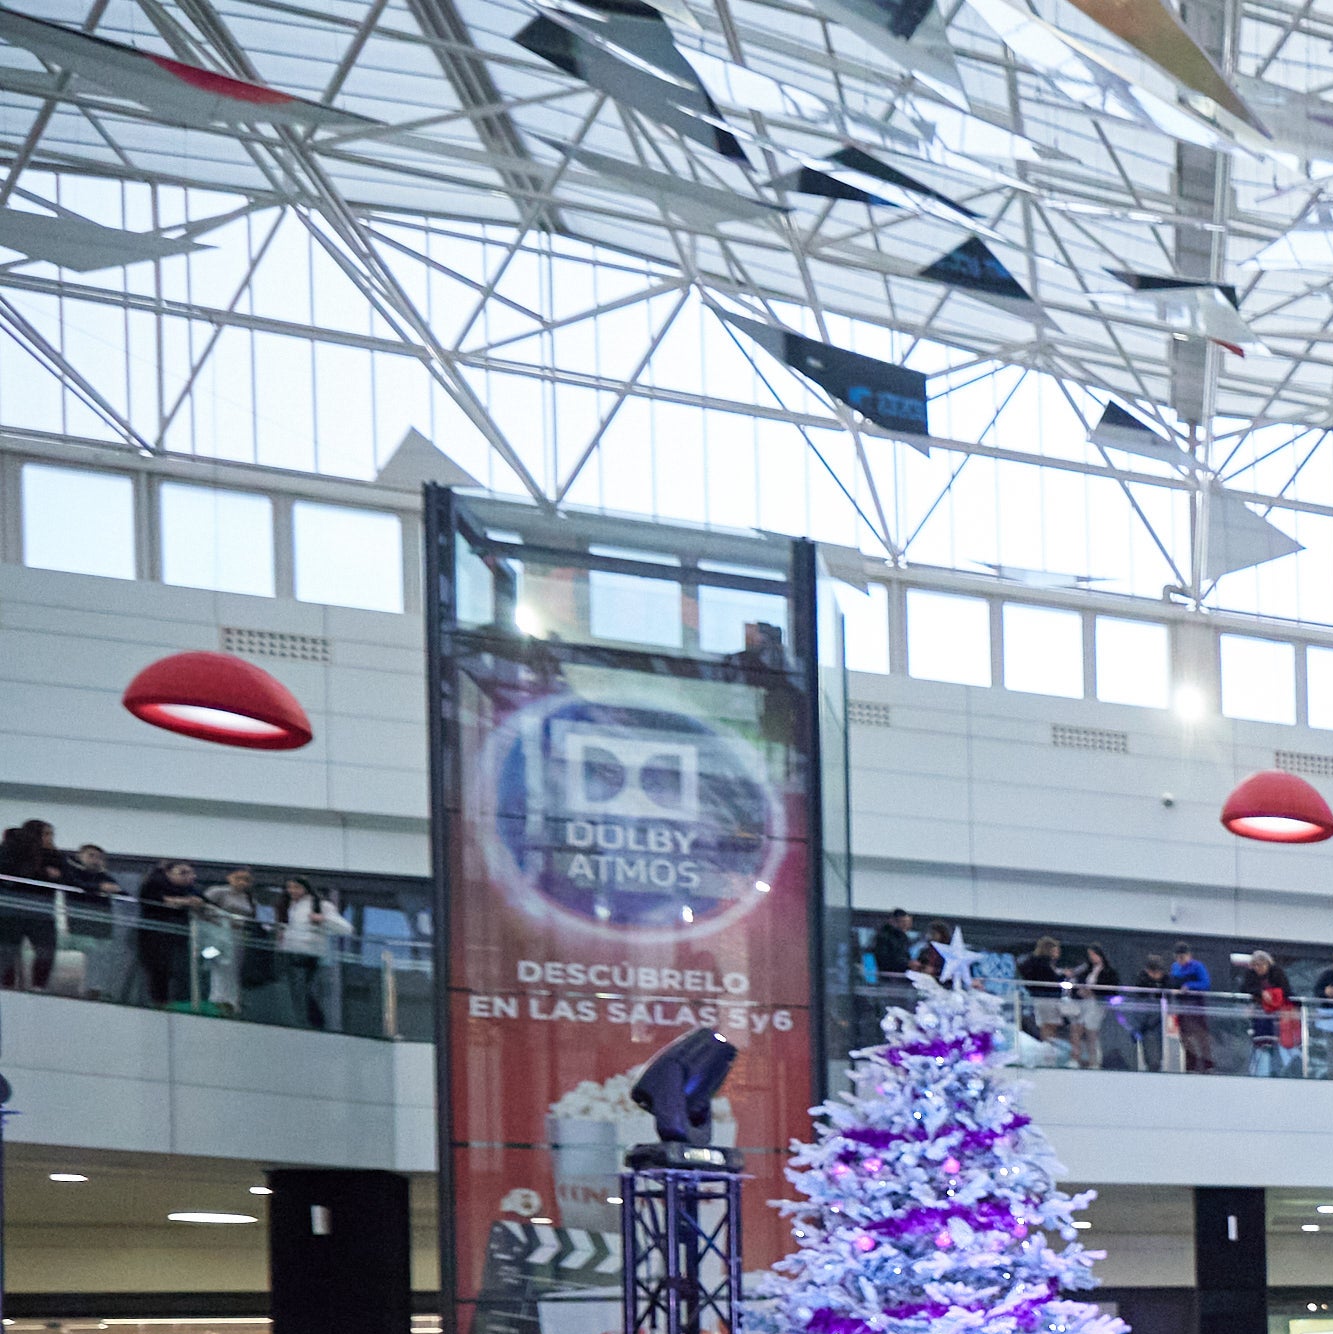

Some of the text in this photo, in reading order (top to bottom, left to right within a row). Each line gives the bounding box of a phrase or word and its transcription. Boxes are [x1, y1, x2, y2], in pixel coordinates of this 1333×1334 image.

[566, 821, 697, 855] DOLBY
[567, 853, 701, 888] ATMOS
[468, 995, 518, 1019] EN
[529, 997, 598, 1022] LAS
[607, 1001, 718, 1028] SALAS
